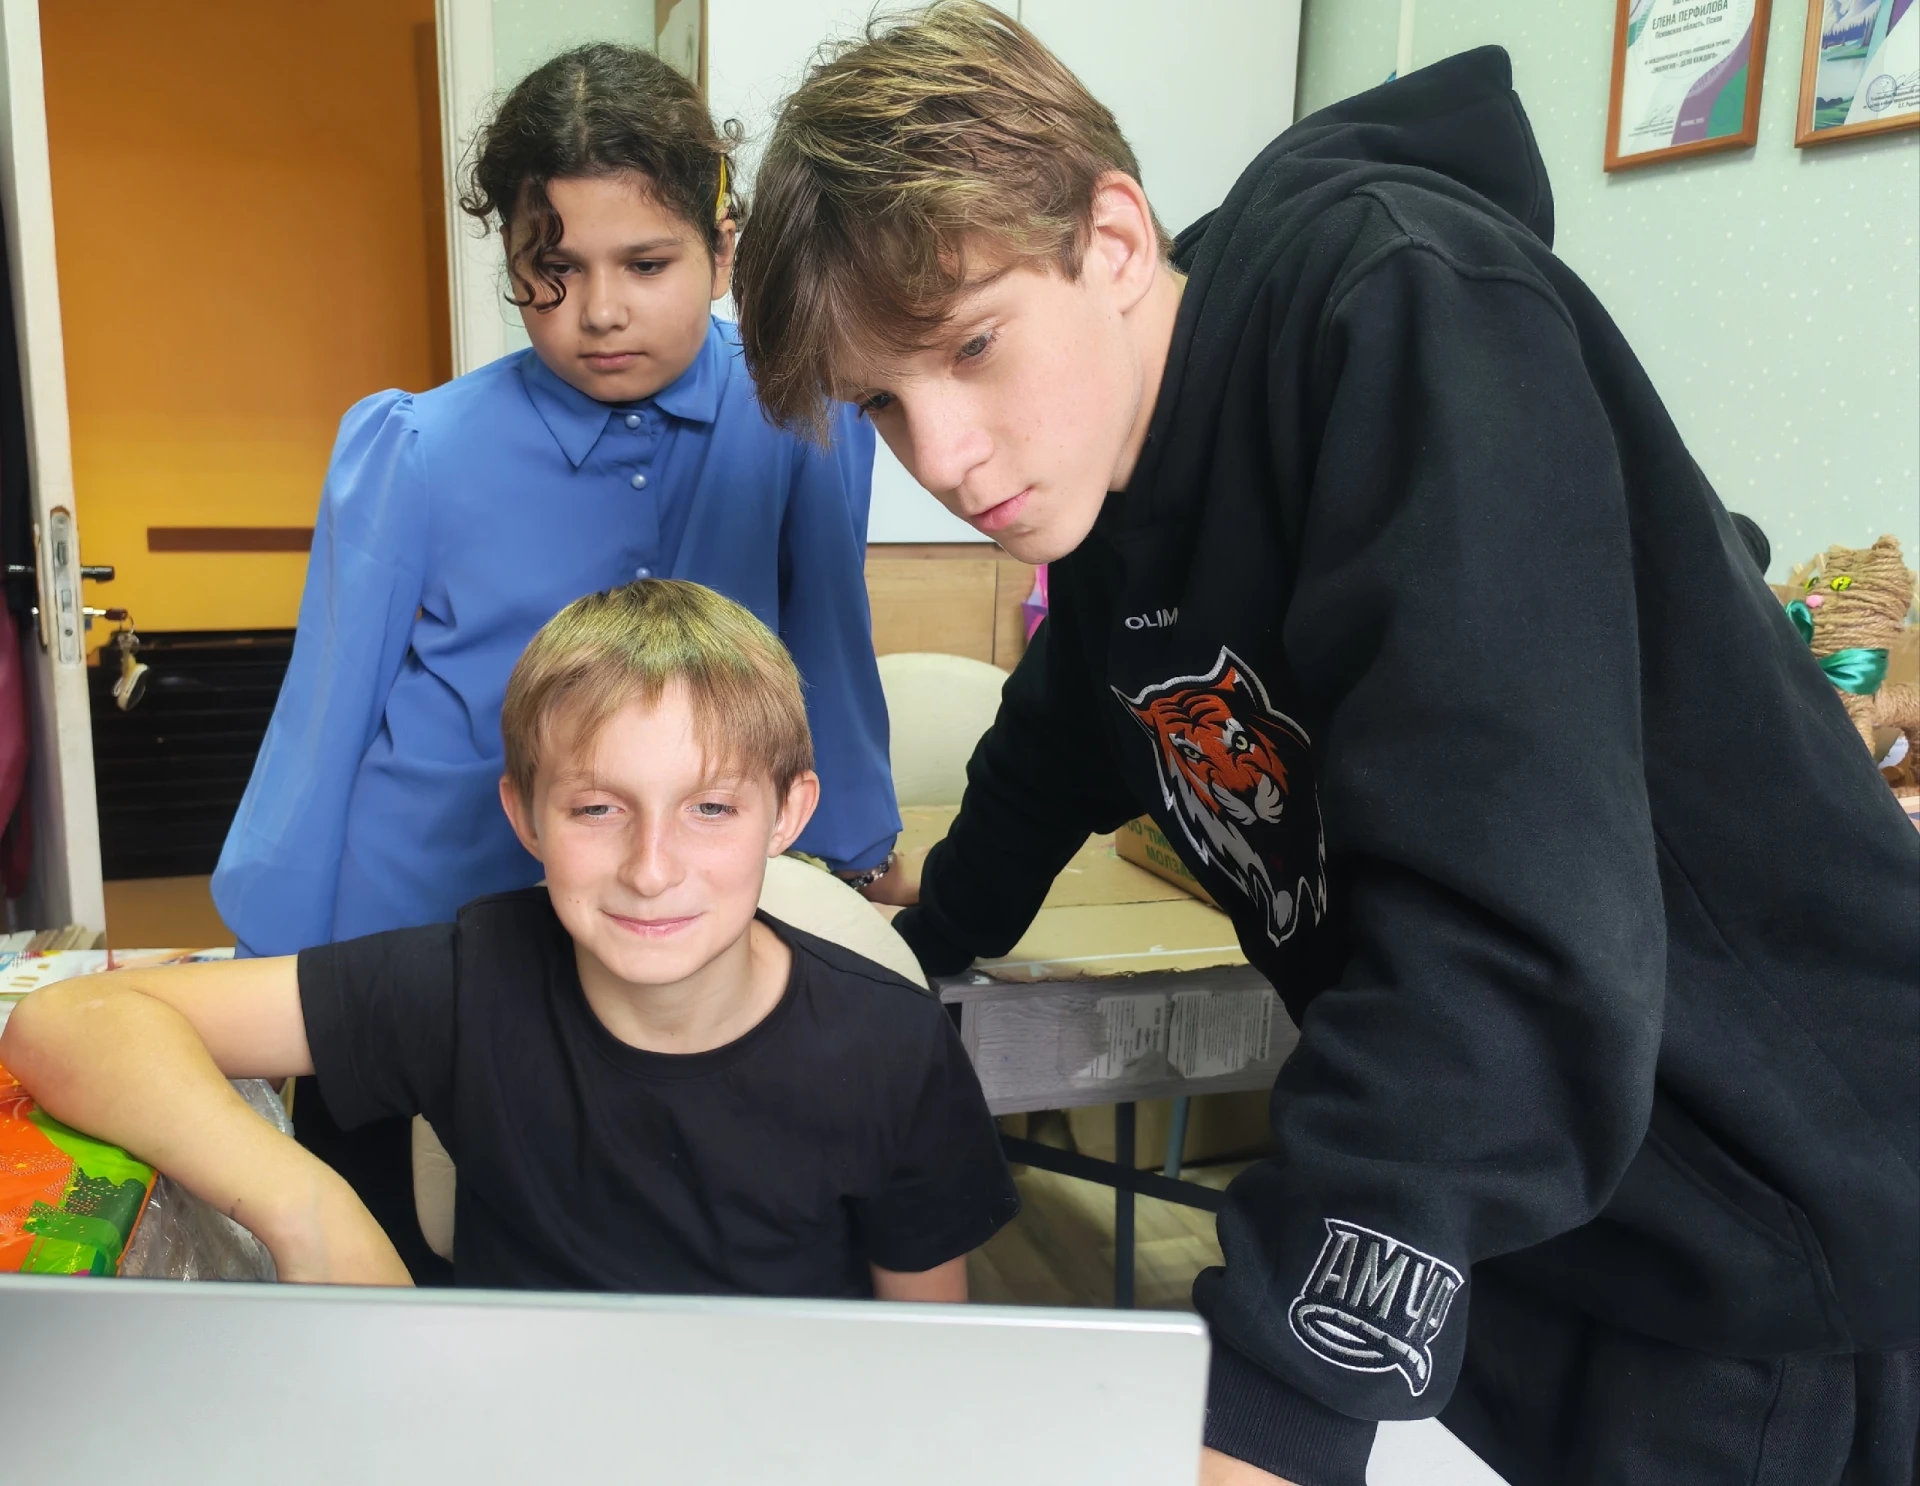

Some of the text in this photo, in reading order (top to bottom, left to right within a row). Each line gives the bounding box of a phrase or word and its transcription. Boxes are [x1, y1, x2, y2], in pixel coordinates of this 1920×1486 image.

[1652, 0, 1728, 30] ЕЛЕНА ПЕРФИЛОВА
[1124, 607, 1179, 630] OLIM
[1145, 844, 1196, 882] МОЛЗА
